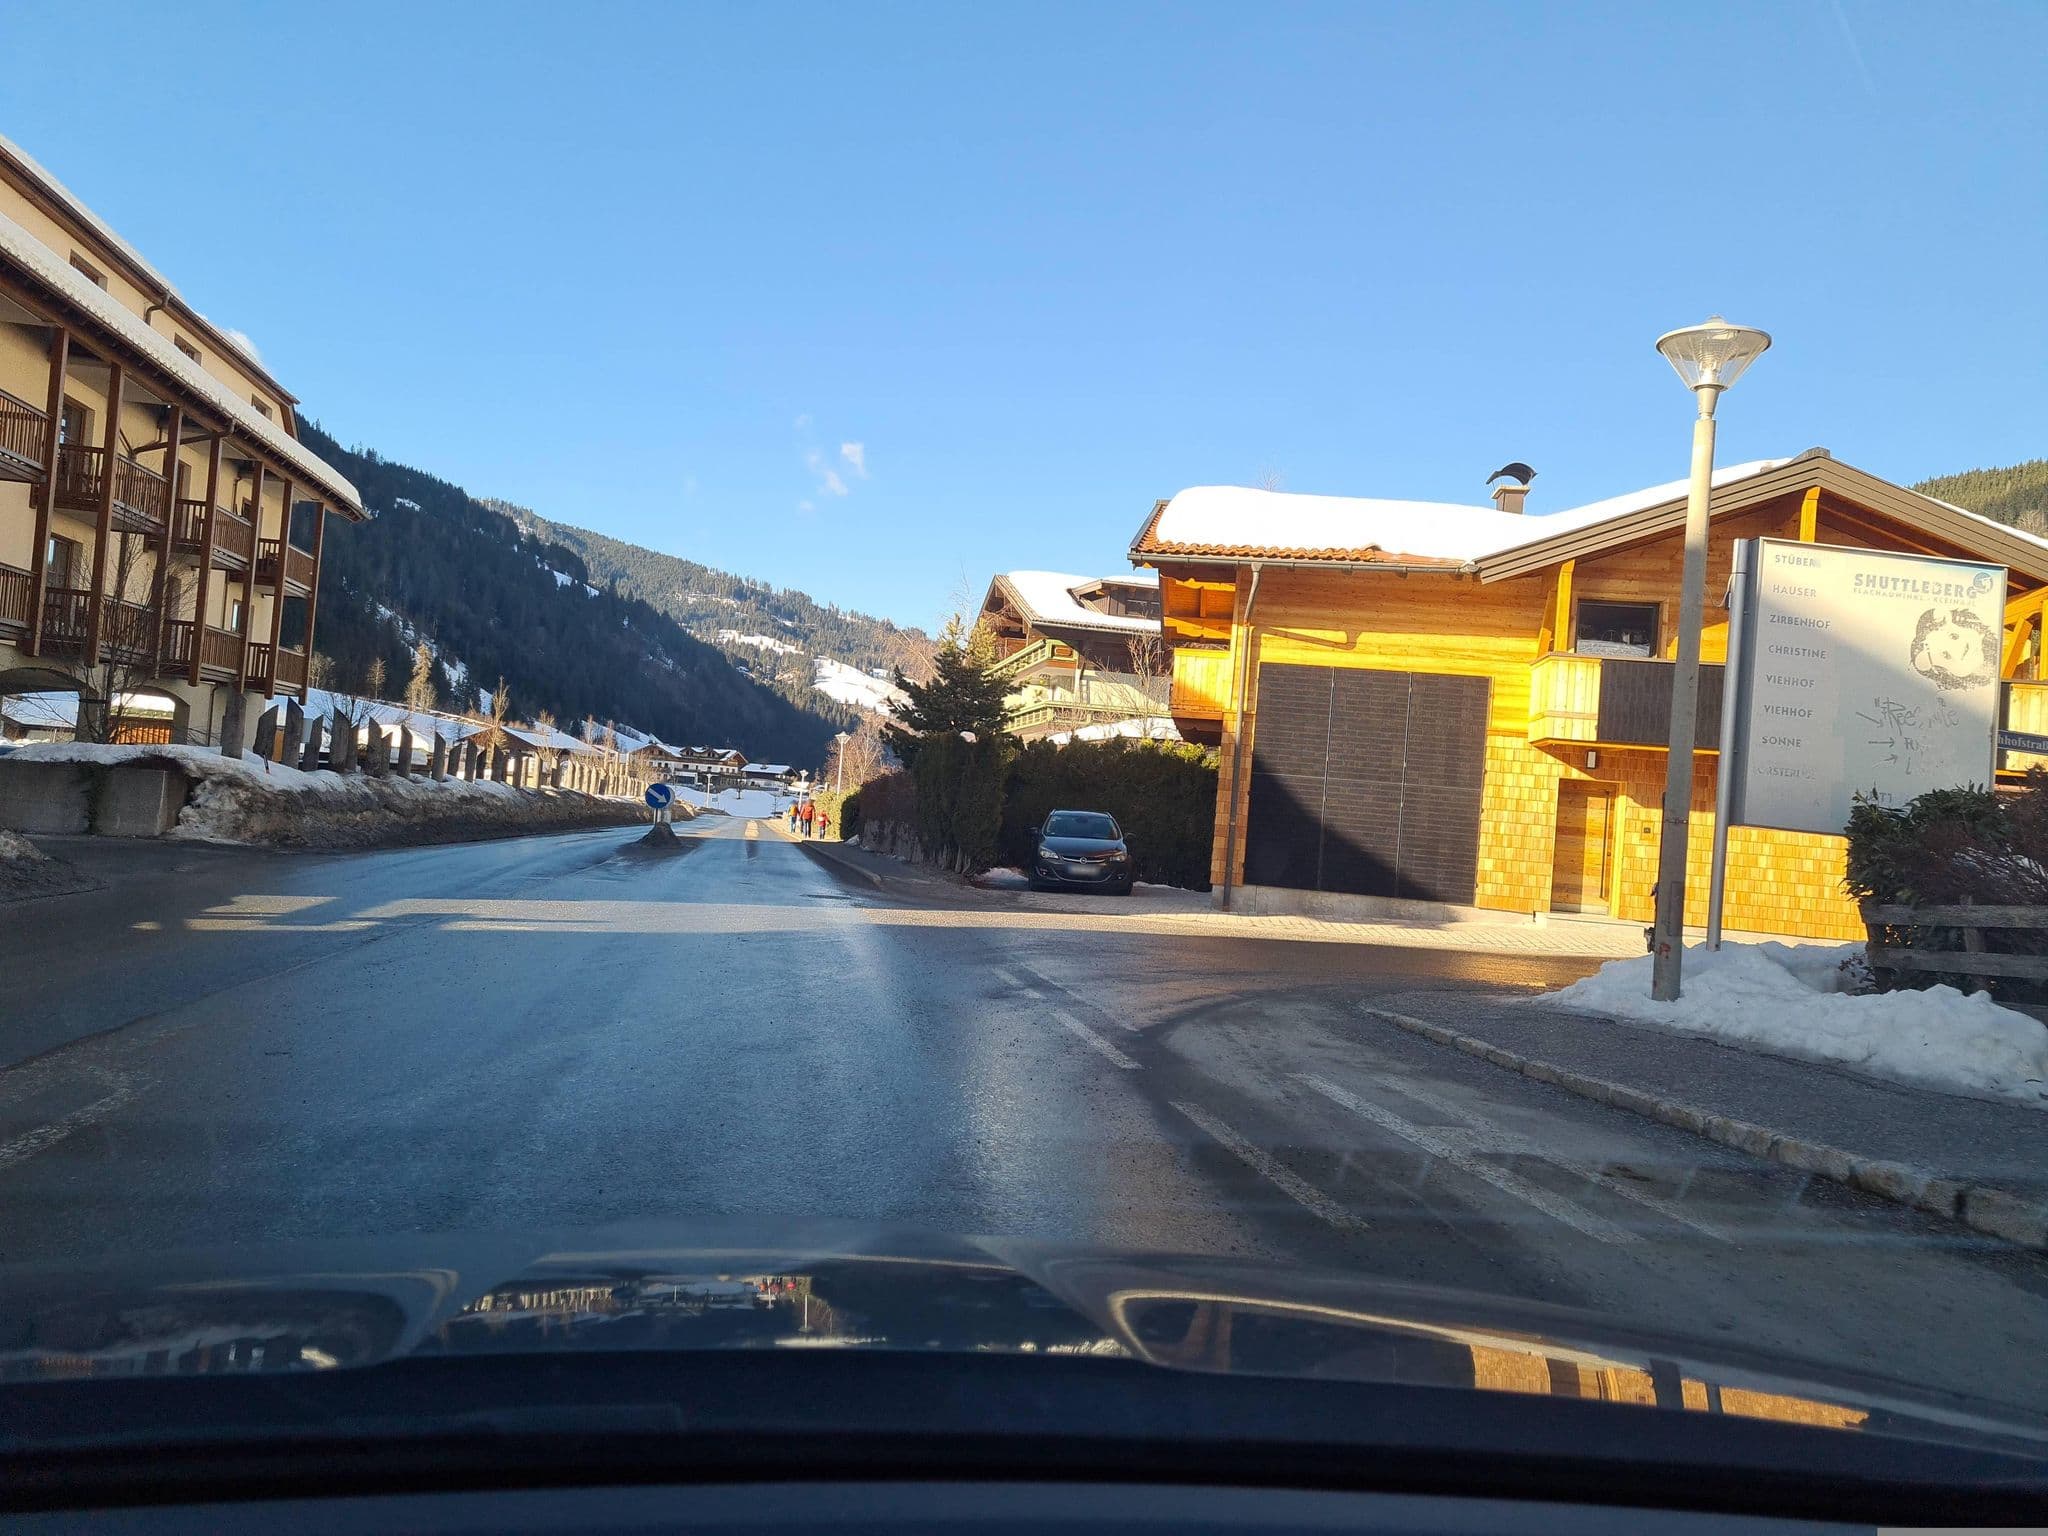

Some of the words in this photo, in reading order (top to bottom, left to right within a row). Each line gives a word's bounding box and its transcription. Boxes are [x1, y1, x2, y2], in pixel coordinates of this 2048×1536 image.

[1772, 584, 1817, 598] HAUSER
[1854, 573, 1977, 599] SHUTTLEBERG
[1769, 614, 1831, 629] ZIRBENHOF
[1768, 645, 1827, 659] CHRISTINE
[1766, 674, 1815, 688] VIEHHOF
[1764, 704, 1813, 718] VIEHHOF
[1761, 735, 1801, 748] SONNE
